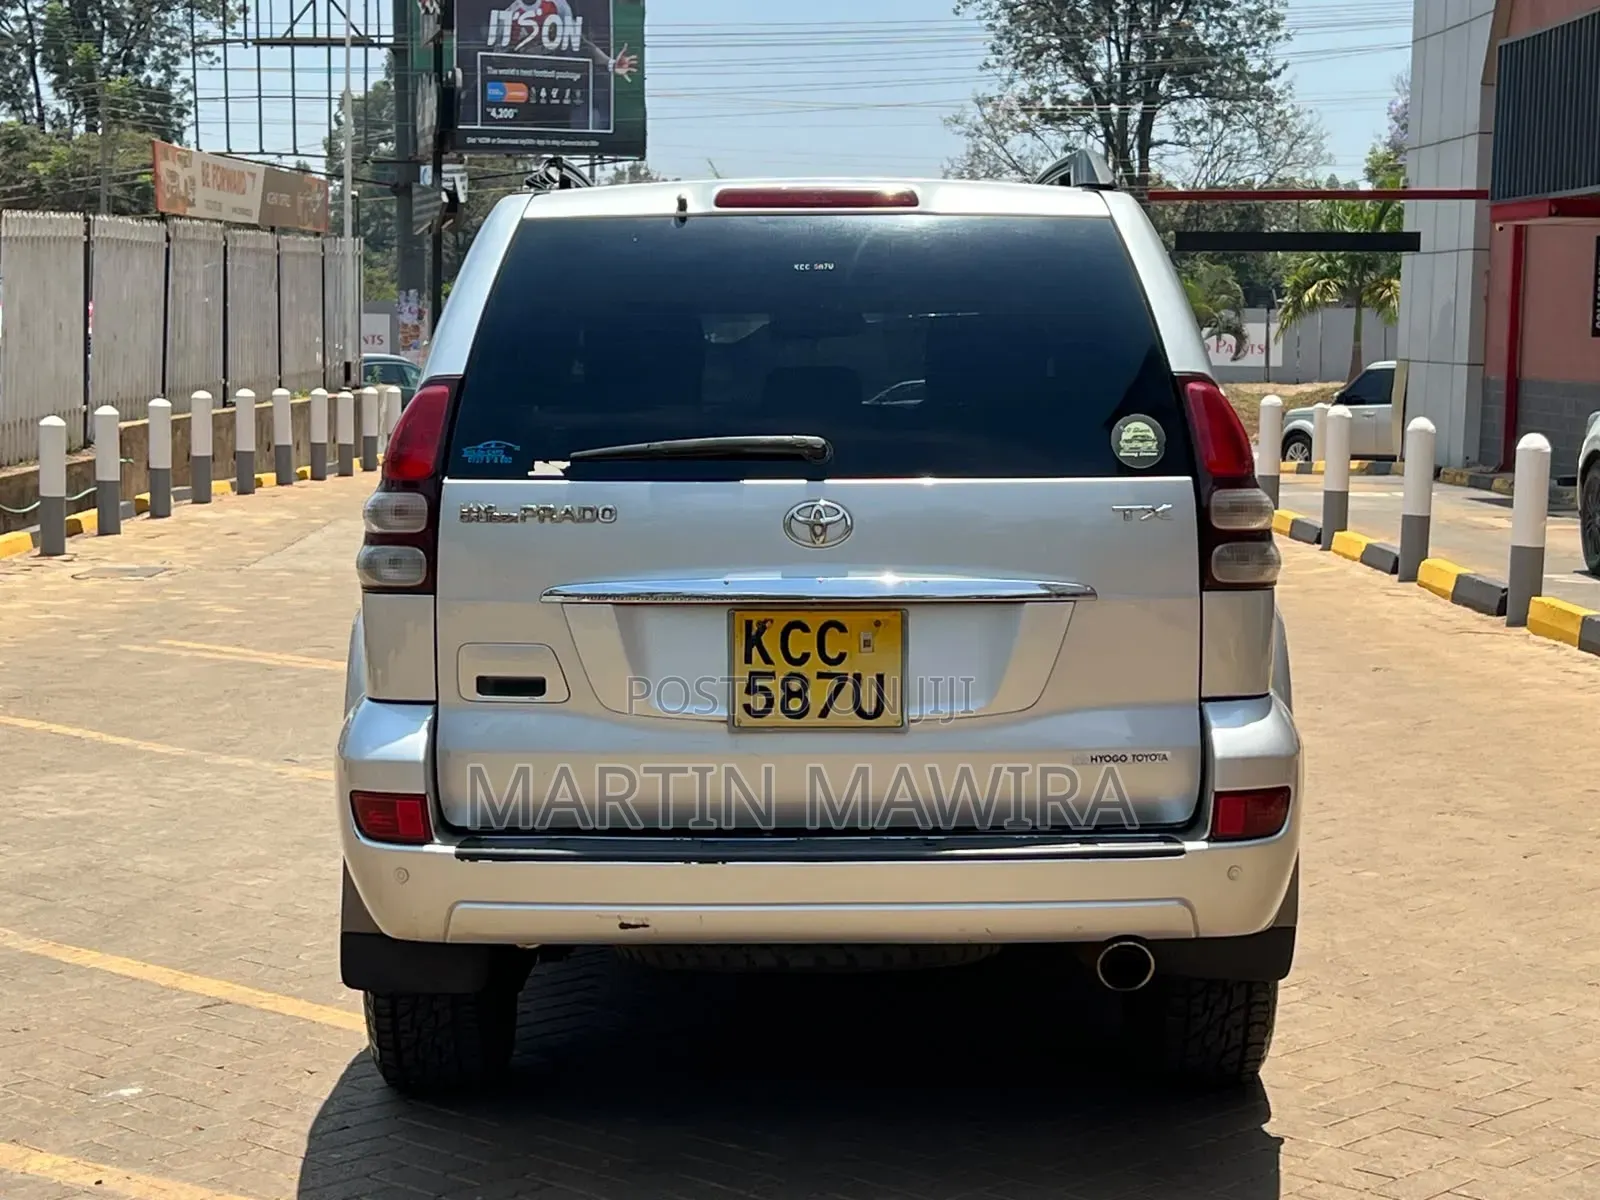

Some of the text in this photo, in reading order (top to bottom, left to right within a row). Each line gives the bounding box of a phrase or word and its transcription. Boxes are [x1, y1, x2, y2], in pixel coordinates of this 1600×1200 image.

[487, 9, 583, 51] IT'S ON
[520, 503, 617, 524] PRADO
[1112, 504, 1173, 521] TX
[743, 618, 850, 667] KCC
[742, 670, 885, 720] 587U
[1090, 754, 1128, 763] HYOGO
[1131, 753, 1169, 763] TOYOTA
